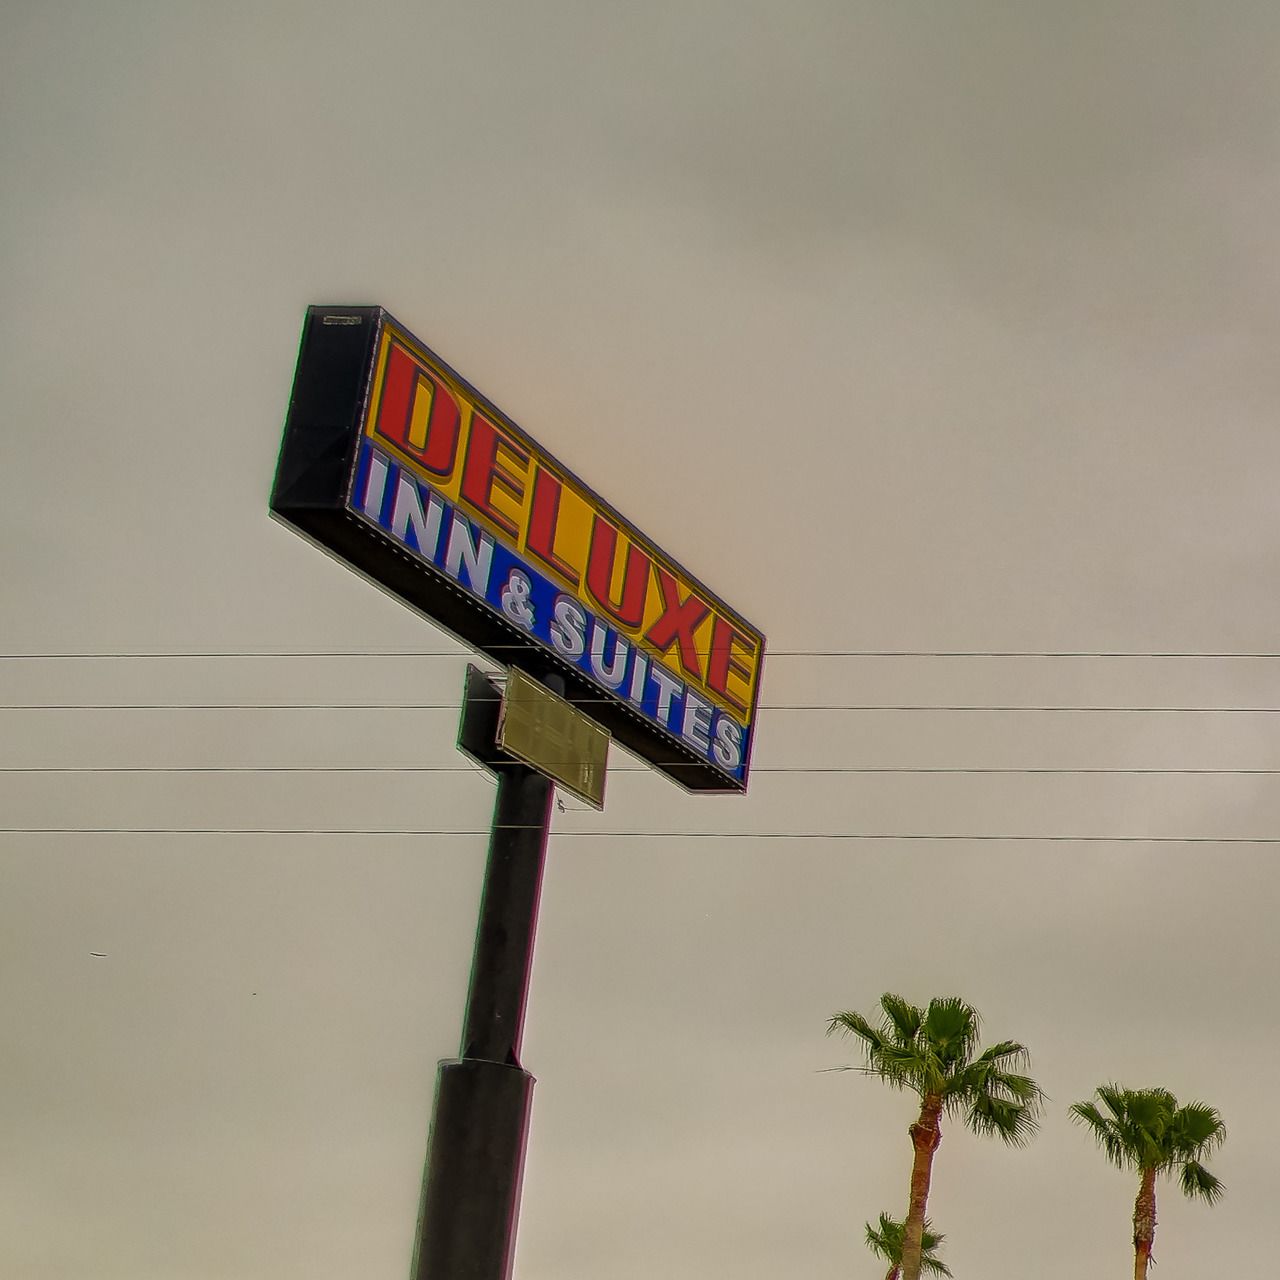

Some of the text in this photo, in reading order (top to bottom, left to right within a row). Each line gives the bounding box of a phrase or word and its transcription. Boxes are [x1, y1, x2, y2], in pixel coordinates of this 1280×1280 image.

[363, 448, 743, 770] INN & SUITES
[375, 336, 757, 720] DELUXE
